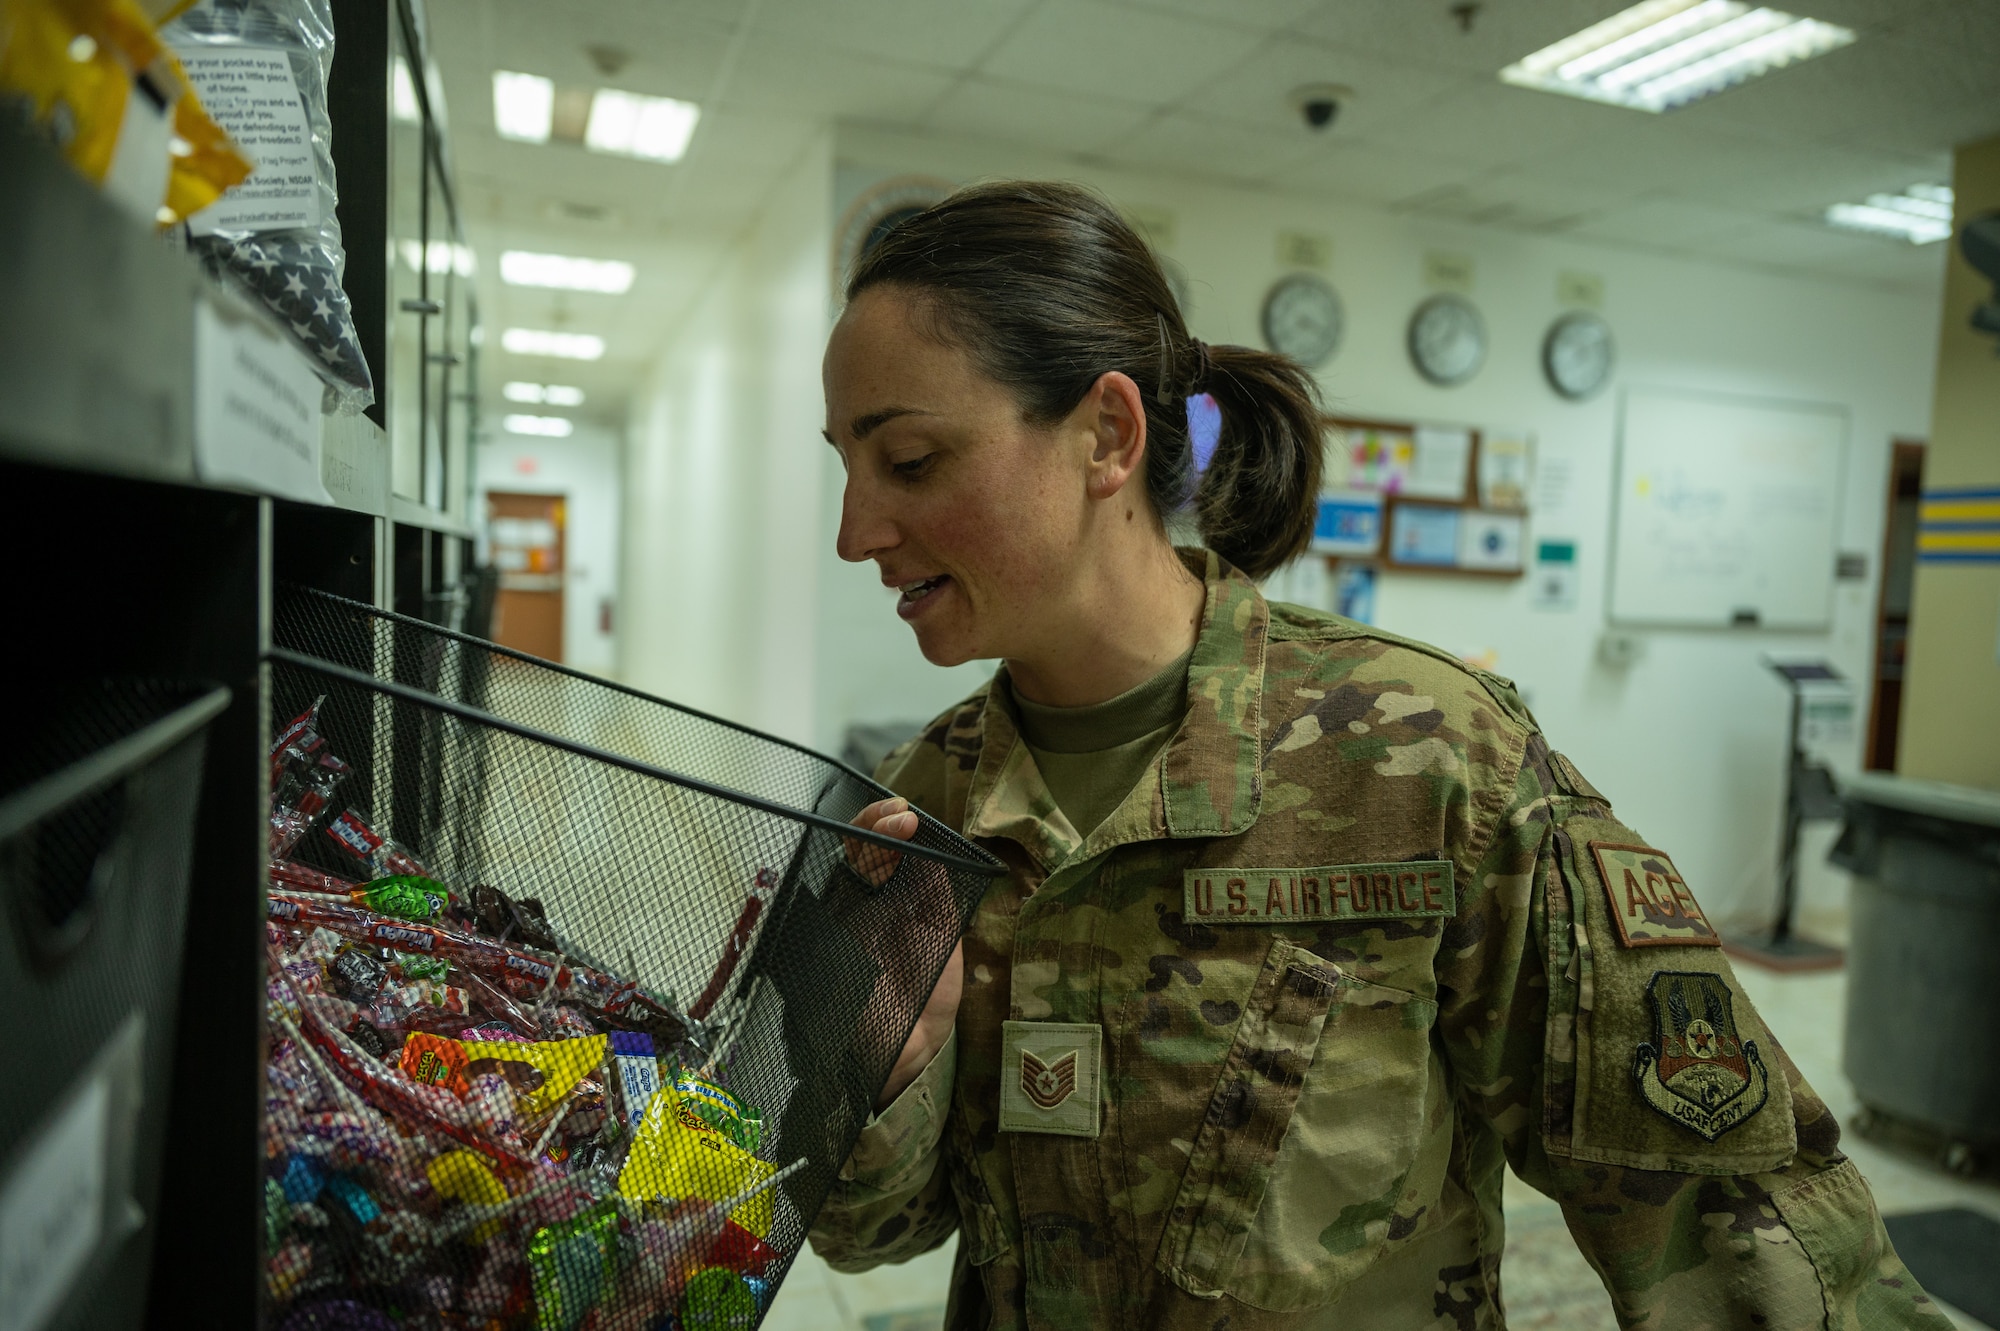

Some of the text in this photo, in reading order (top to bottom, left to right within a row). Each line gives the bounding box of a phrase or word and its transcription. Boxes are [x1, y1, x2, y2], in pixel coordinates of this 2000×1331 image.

[197, 60, 219, 69] your
[223, 59, 255, 69] pocket
[269, 62, 284, 70] you
[210, 72, 234, 81] carry
[245, 71, 264, 80] little
[267, 73, 288, 83] piece
[207, 85, 218, 94] of
[252, 99, 267, 108] you
[270, 99, 284, 107] and
[287, 100, 298, 108] we
[214, 110, 243, 120] proud
[246, 110, 255, 118] of
[226, 123, 240, 132] for
[242, 123, 286, 134] defending
[241, 136, 256, 144] our
[263, 157, 278, 166] Flag
[289, 176, 312, 184] NSDAR
[1194, 872, 1444, 916] U.S. AIR FORCE
[1623, 868, 1702, 920] AGE
[414, 1050, 435, 1083] eese's
[640, 1067, 652, 1092] Grape
